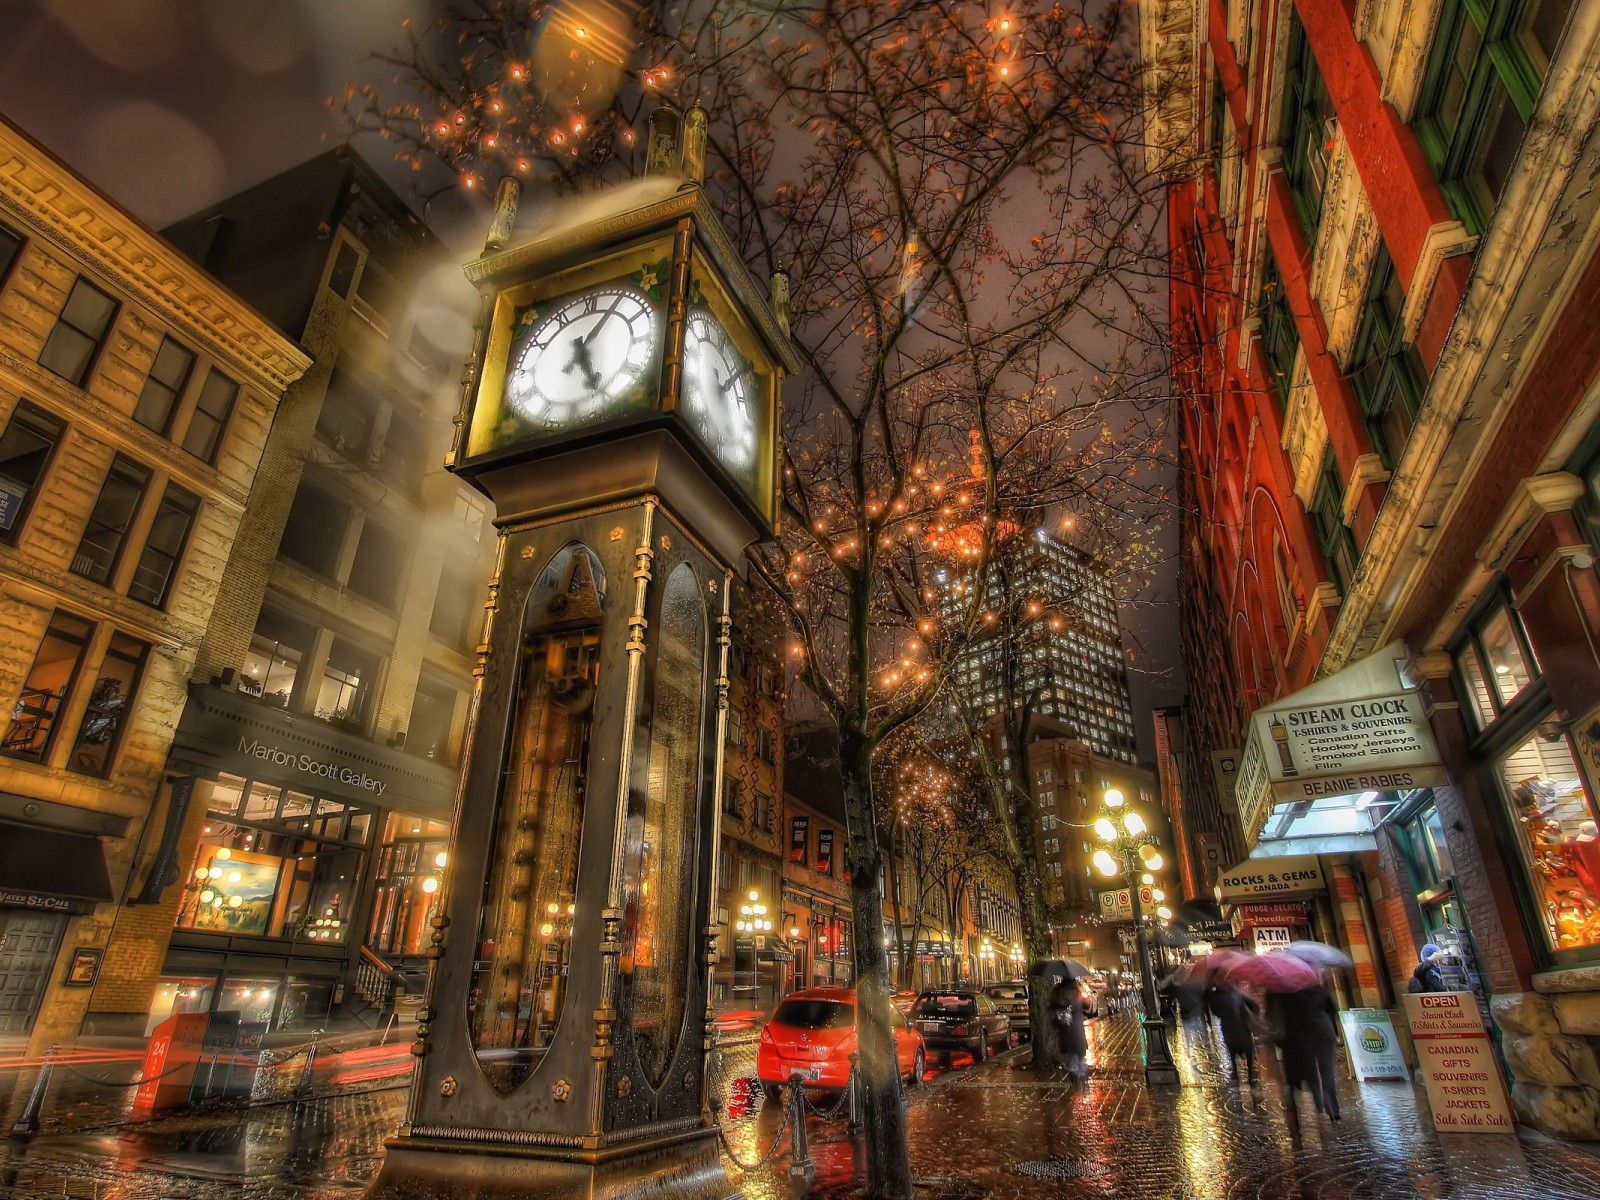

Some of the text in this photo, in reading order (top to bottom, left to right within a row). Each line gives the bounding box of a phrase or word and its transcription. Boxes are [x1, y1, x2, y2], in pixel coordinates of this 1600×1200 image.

[1288, 700, 1408, 726] STEAM CLOCK
[1292, 716, 1412, 738] T-SHIRTS & SOUVENIRS
[1308, 728, 1406, 745] Canadian Gifts
[1310, 736, 1415, 753] Hockey Jerseys
[1313, 744, 1421, 761] Smoked Salmon
[238, 736, 386, 796] Marion Scott Gallery
[1316, 762, 1342, 770] Film
[1303, 772, 1413, 796] BEANIE BABIES
[1223, 870, 1317, 887] ROCKS & GEMS
[1254, 883, 1290, 892] CANADA
[1245, 905, 1269, 913] FUDGE
[1258, 930, 1287, 940] ATM
[1423, 996, 1456, 1007] OPEN
[1422, 1010, 1464, 1019] Steam Clock
[1440, 1021, 1446, 1029] &
[1448, 1020, 1482, 1028] Souvenirs
[153, 1042, 166, 1056] 24
[1428, 1046, 1478, 1054] CANADIAN
[1442, 1086, 1486, 1095] T-SHIRTS
[1446, 1100, 1490, 1109] JACKETS
[1436, 1113, 1509, 1126] Sale Sale Sale
